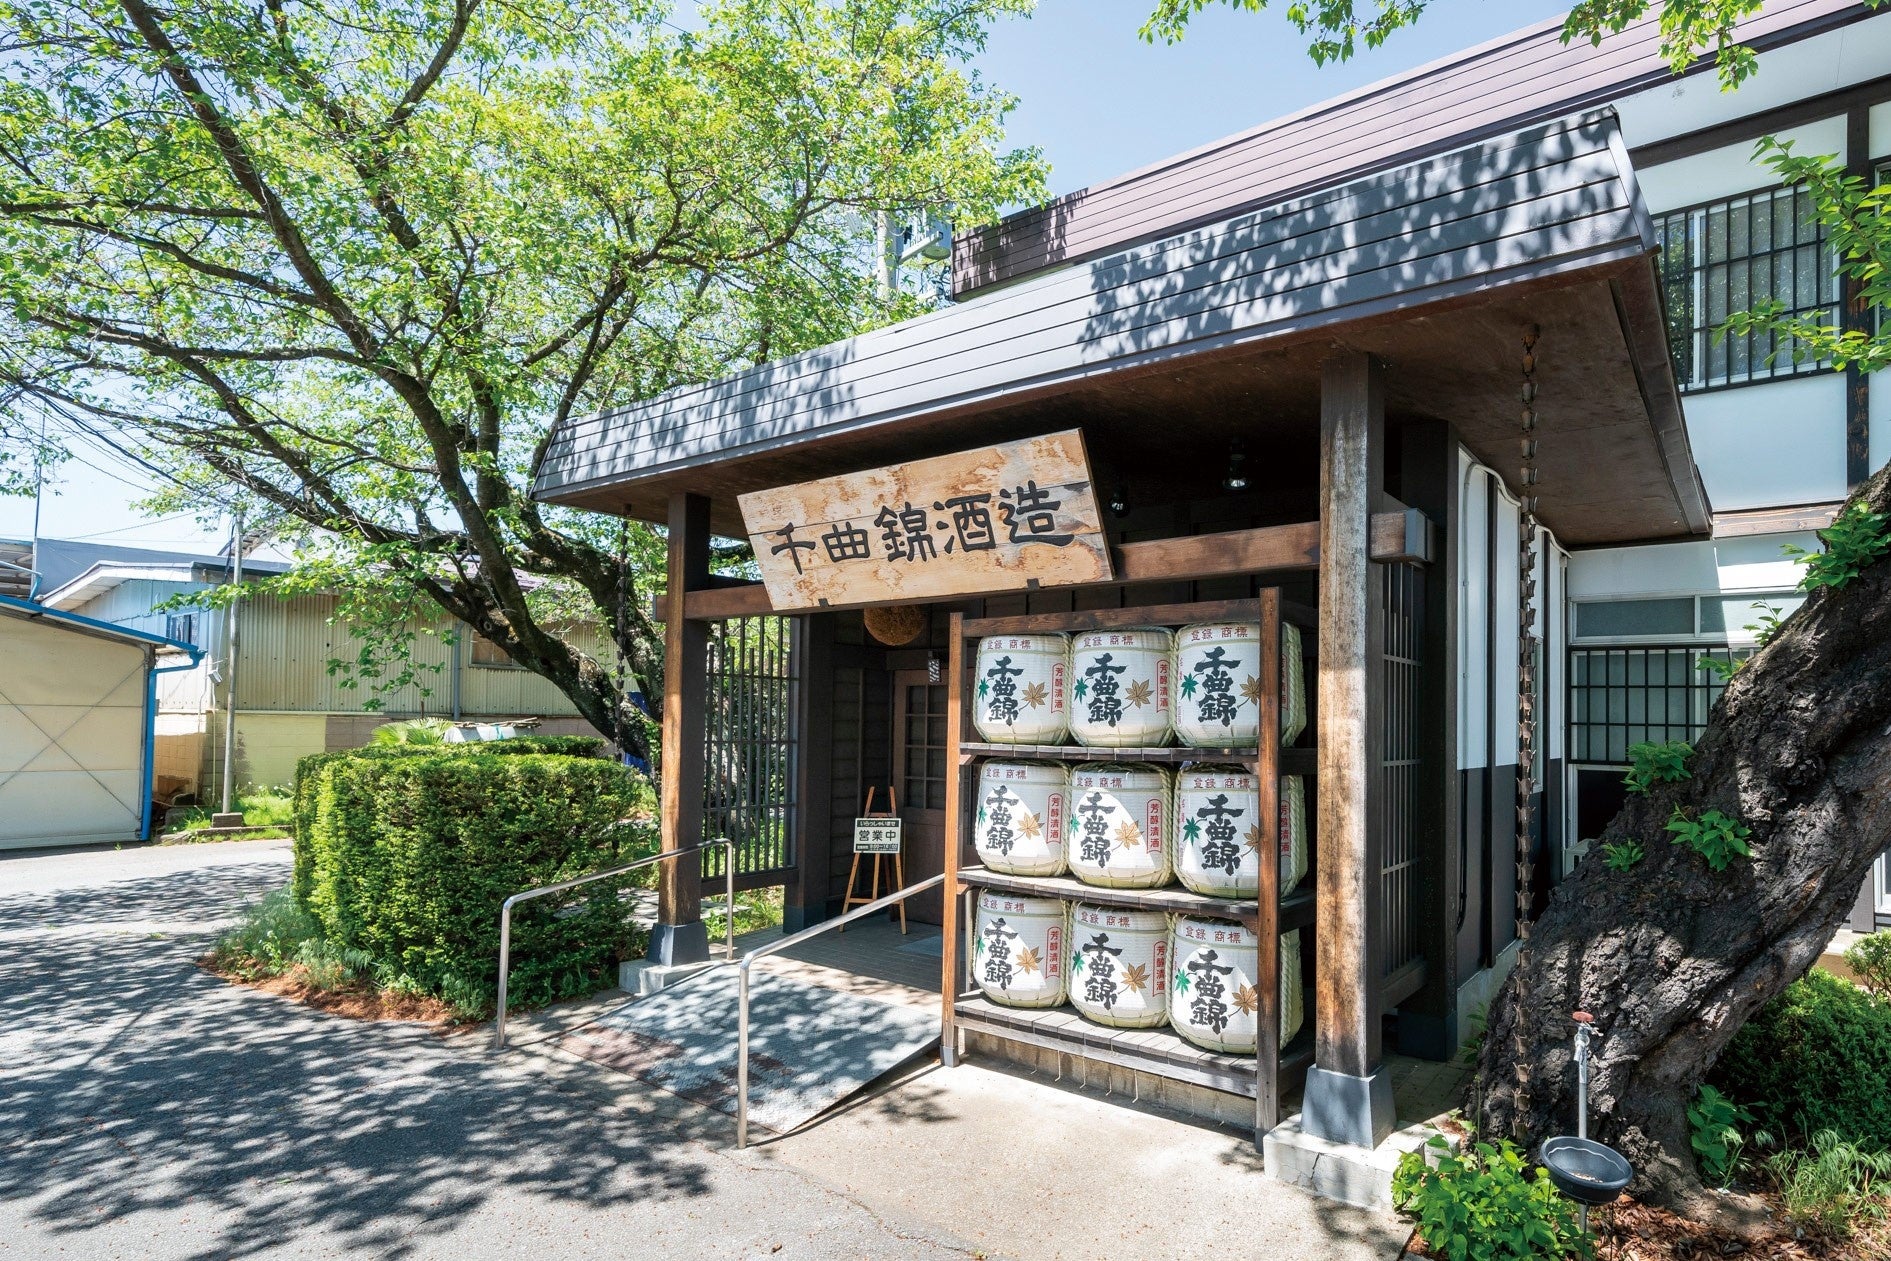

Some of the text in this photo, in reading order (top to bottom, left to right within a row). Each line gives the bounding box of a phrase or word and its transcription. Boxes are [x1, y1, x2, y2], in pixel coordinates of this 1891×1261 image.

[771, 480, 1075, 575] 千曲錦酒造
[987, 655, 1024, 727] 千曲錦
[1085, 652, 1128, 728] 千曲錦
[1193, 646, 1242, 727] 千曲錦
[859, 830, 896, 842] 営業中
[986, 785, 1019, 857] 千曲錦
[1050, 797, 1060, 839] 芳醇清酒
[1078, 792, 1117, 869] 千曲錦
[1150, 803, 1159, 848] 芳醇清酒
[1196, 793, 1245, 876] 千曲錦
[984, 917, 1019, 990] 千曲錦
[1049, 931, 1059, 973] 芳醇清酒
[1082, 932, 1123, 1010] 千曲錦
[1188, 949, 1235, 1035] 千曲錦
